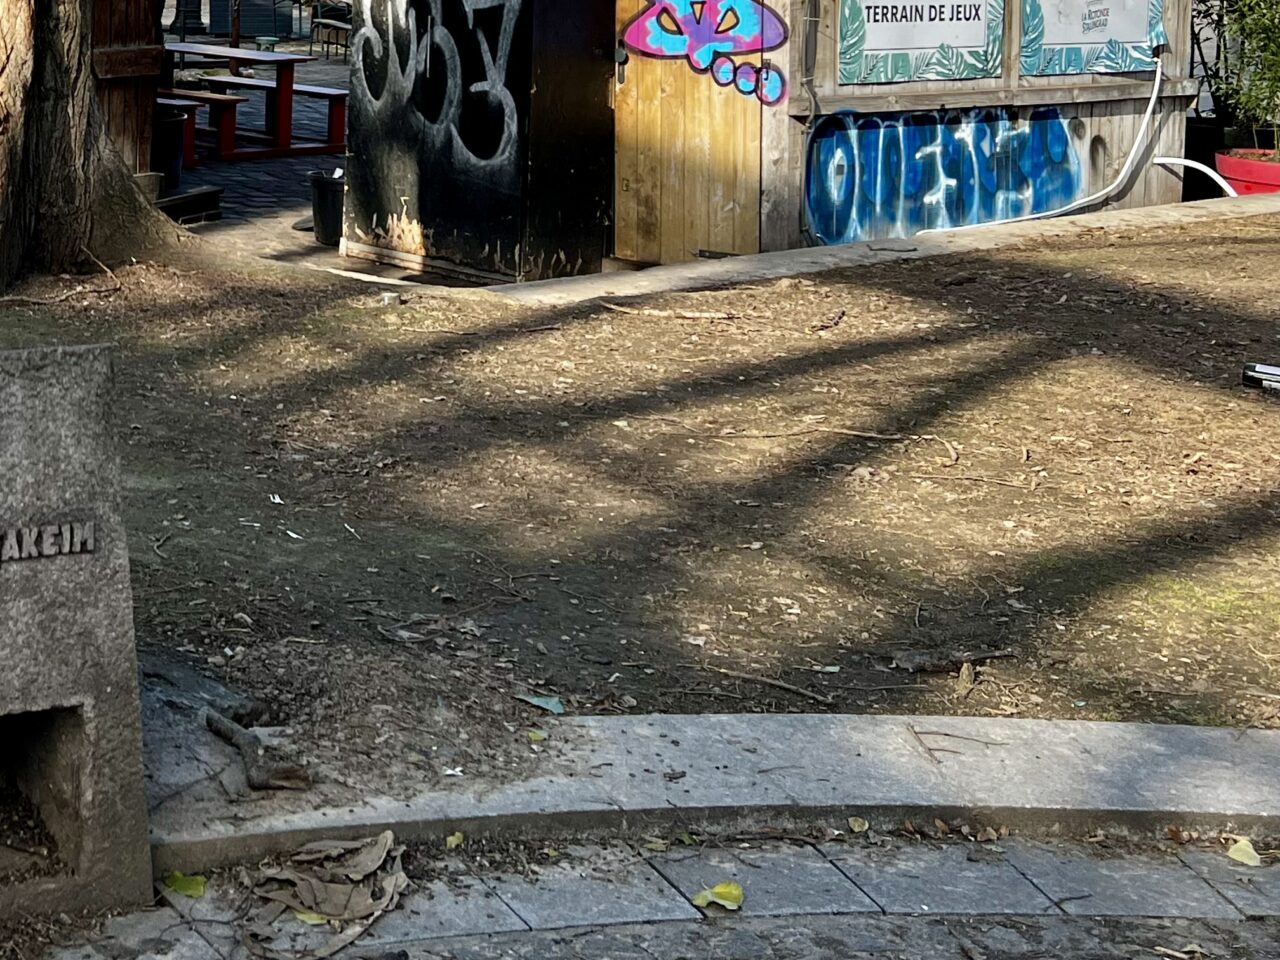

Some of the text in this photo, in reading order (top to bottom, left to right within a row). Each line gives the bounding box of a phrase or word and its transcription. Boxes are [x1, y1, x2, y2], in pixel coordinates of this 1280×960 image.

[865, 3, 982, 23] TERRAIN DE JEUX
